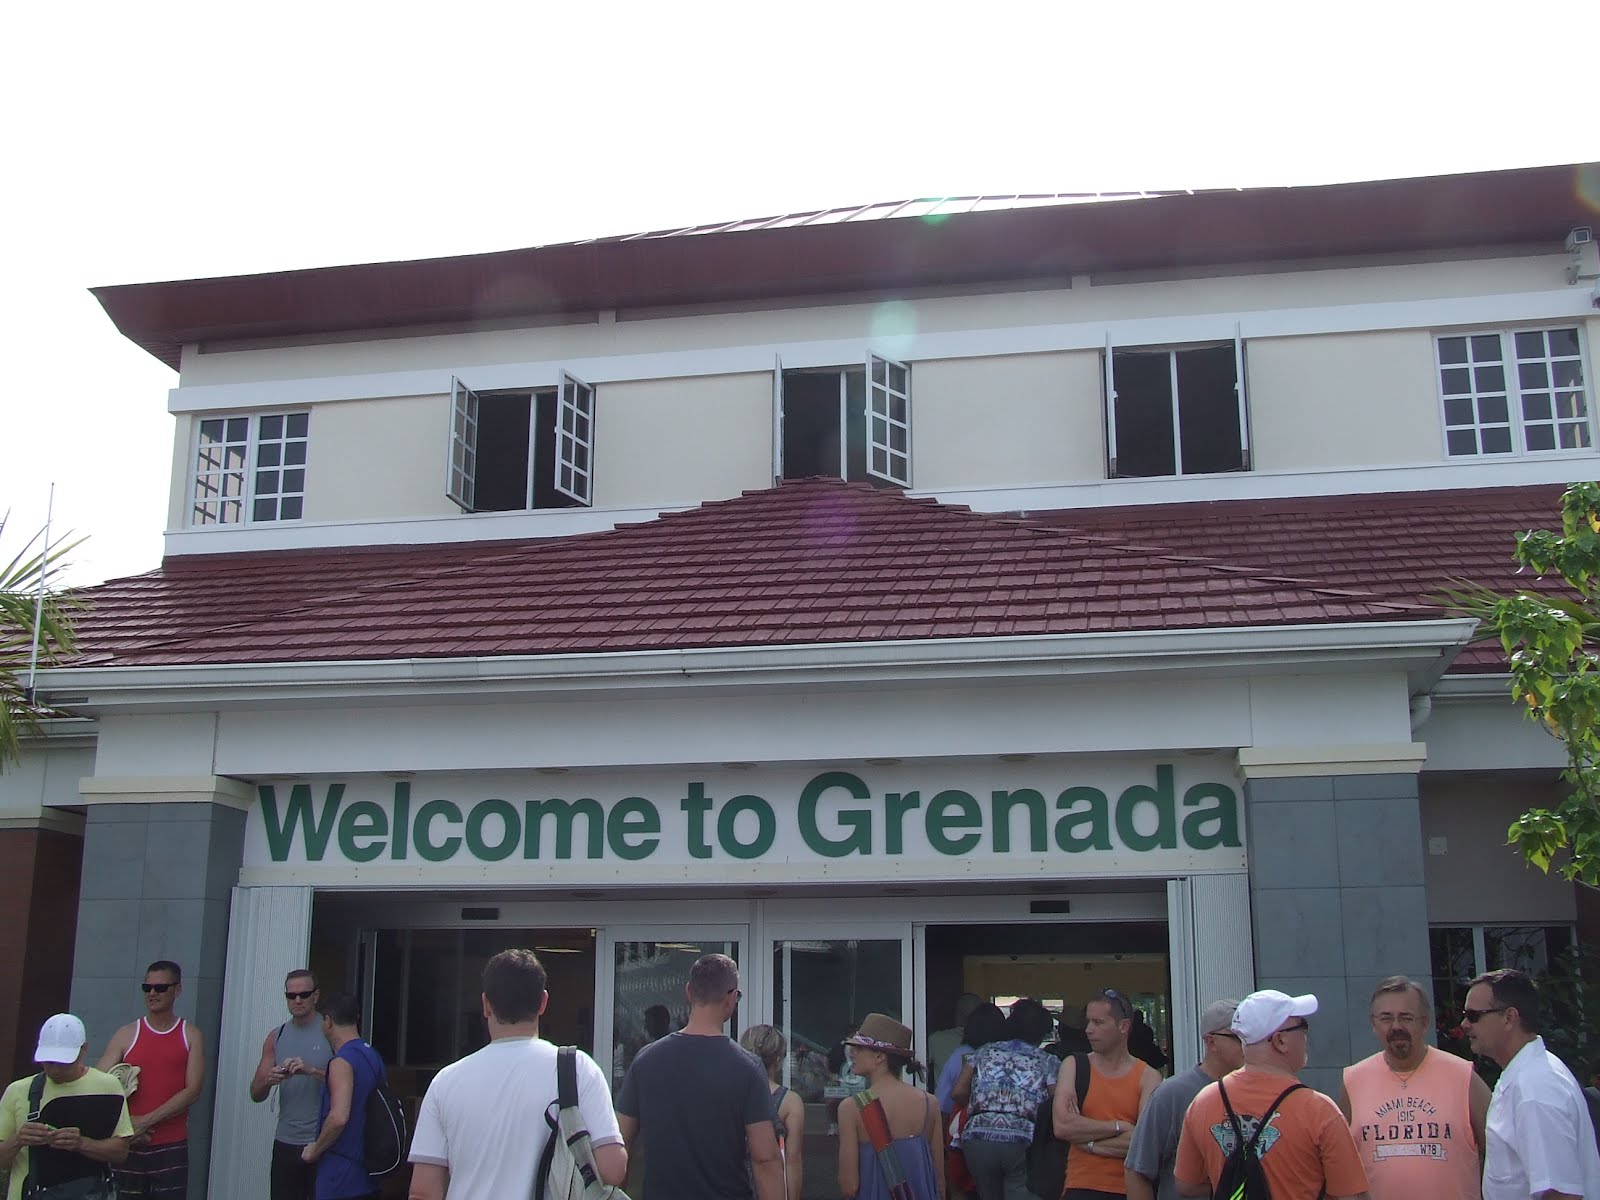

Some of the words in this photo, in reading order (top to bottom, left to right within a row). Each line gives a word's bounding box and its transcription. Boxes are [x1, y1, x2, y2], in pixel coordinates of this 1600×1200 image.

[257, 782, 661, 862] Welcome
[680, 782, 776, 859] to
[797, 764, 1242, 858] Grenada
[1374, 1098, 1404, 1118] MIAMI
[1407, 1097, 1437, 1116] BEACH
[1397, 1110, 1415, 1122] 1915
[1361, 1122, 1452, 1141] FLORIDA
